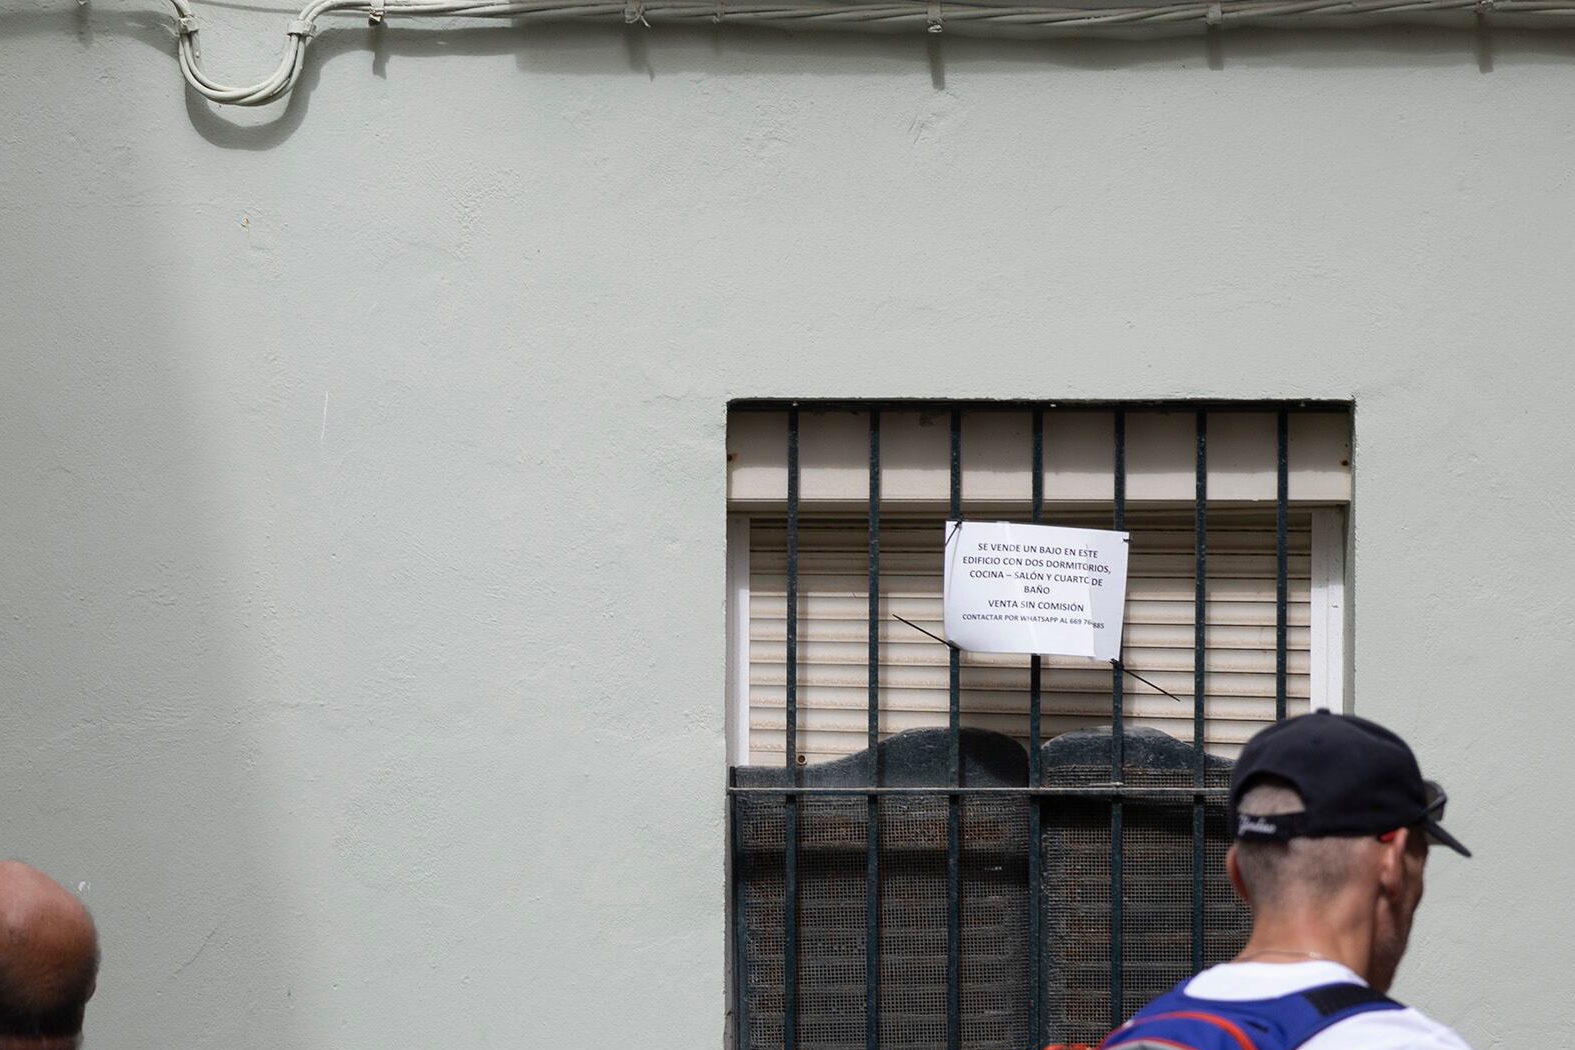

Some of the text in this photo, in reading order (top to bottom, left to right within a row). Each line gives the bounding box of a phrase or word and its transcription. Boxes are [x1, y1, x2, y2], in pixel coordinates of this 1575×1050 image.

[978, 543, 1098, 558] SE VENDE UN BAJO EN ESTE
[963, 556, 1111, 575] EDIFICIO CON DOS DORMITORIOS,
[969, 570, 1004, 578] COCINA
[1014, 571, 1044, 580] SALÓN
[1046, 573, 1052, 581] Y
[1091, 578, 1103, 587] DE
[1024, 584, 1050, 595] BAÑO
[988, 599, 1084, 612] VENTA SIN COMISIÓN
[962, 613, 1003, 621] CONTACTAR
[1020, 615, 1058, 623] WHATSAPP
